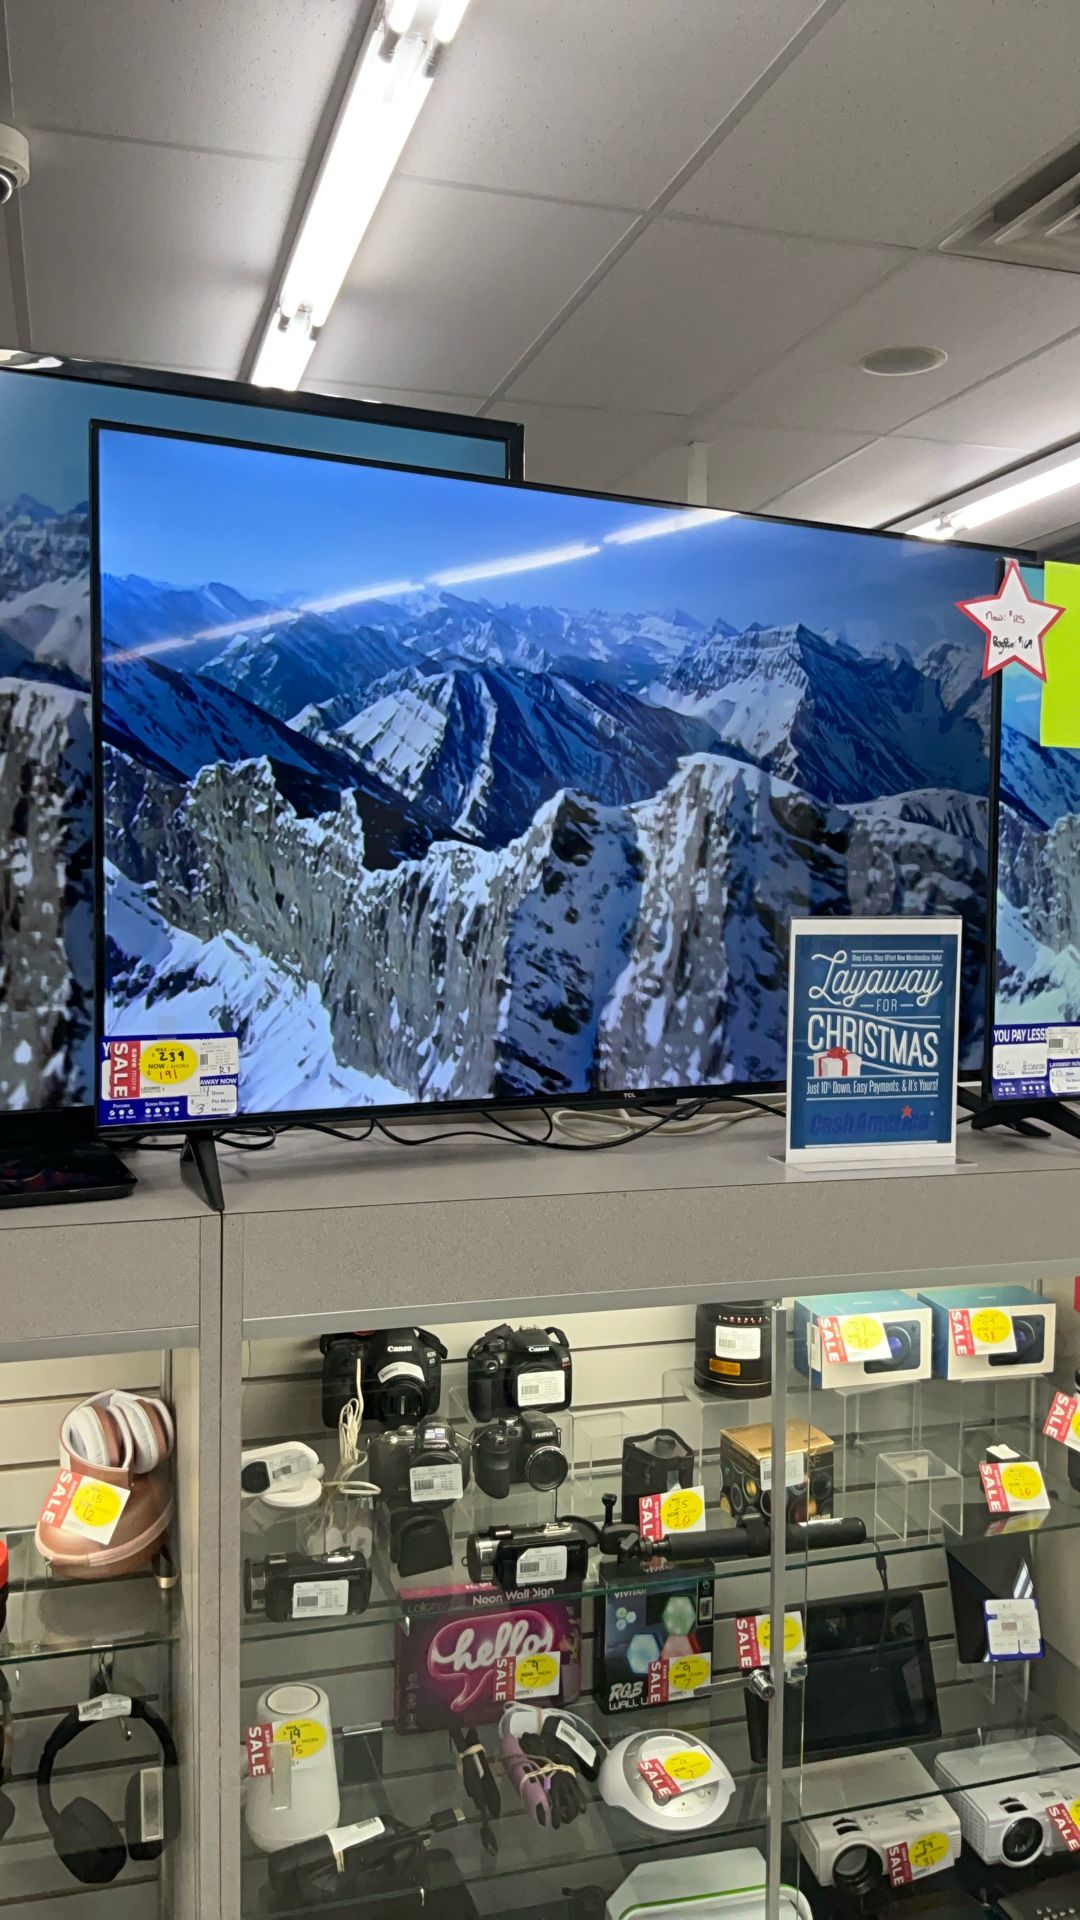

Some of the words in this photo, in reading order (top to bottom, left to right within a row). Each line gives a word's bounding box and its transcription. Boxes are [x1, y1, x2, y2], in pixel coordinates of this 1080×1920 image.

[809, 950, 943, 1007] Layaway
[876, 999, 898, 1012] FOR
[160, 1051, 185, 1062] 239
[807, 1014, 940, 1068] CHRISTMAS
[994, 1029, 1010, 1042] YOU
[1012, 1029, 1027, 1042] PAY
[114, 1043, 128, 1097] SALE
[159, 1070, 178, 1080] 191
[807, 1082, 819, 1095] Just
[853, 1081, 868, 1095] Easy
[901, 1080, 907, 1092] &
[918, 1079, 939, 1091] Yours!
[821, 1318, 840, 1362] SALE
[951, 1311, 968, 1355] SALE
[1045, 1393, 1069, 1438] SALE
[42, 1470, 73, 1524] SALE
[982, 1464, 1001, 1511] SALE
[473, 1595, 502, 1605] Neon
[505, 1588, 529, 1600] Wall
[431, 1620, 553, 1671] hello
[737, 1619, 752, 1667] SALE
[495, 1658, 507, 1701] SALE
[609, 1681, 643, 1702] RGB
[651, 1661, 661, 1703] SALE
[609, 1699, 638, 1711] WALL
[249, 1726, 266, 1776] SALE
[640, 1762, 671, 1797] SALE
[1049, 1806, 1080, 1850] SALE
[889, 1846, 904, 1886] SALE
